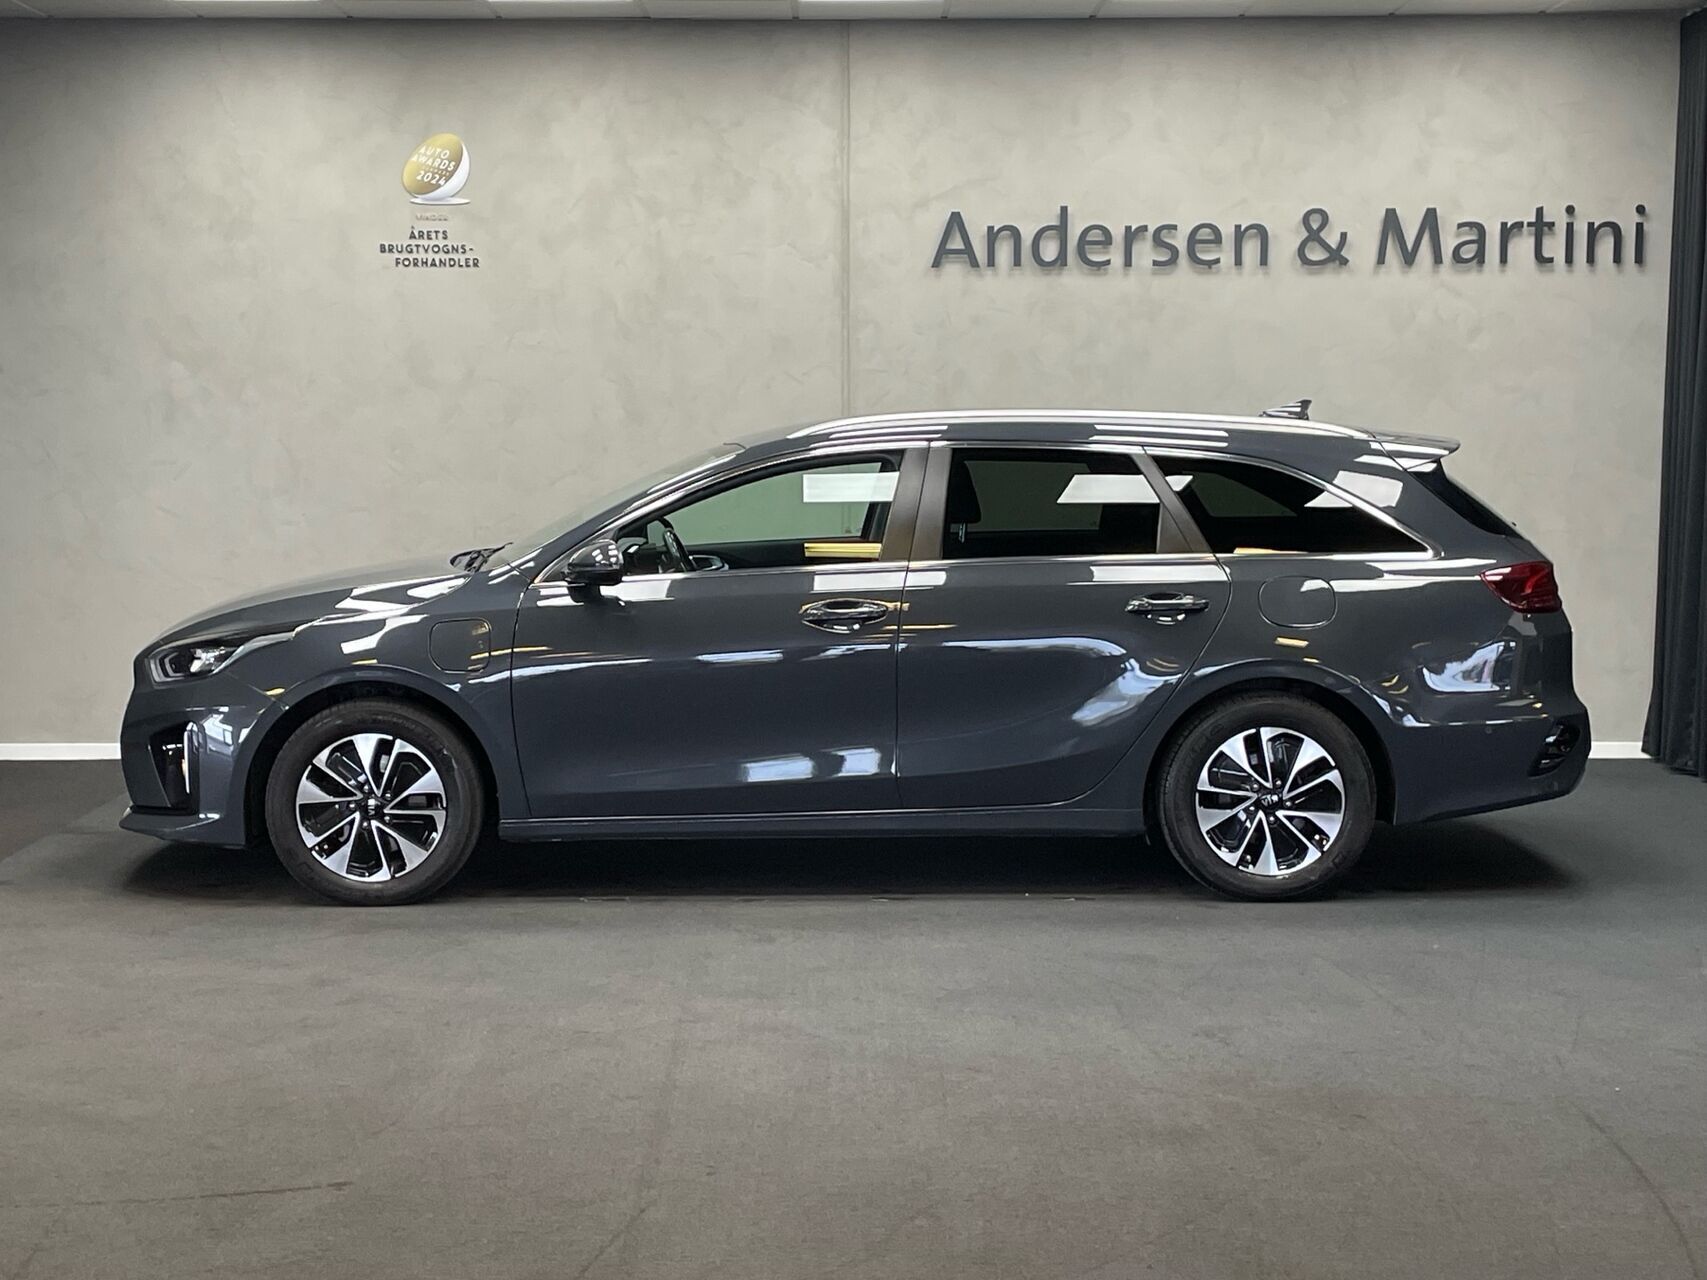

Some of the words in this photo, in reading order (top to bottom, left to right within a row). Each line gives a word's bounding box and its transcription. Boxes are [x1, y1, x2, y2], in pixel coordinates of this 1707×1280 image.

[419, 145, 450, 159] AUTO
[411, 154, 456, 171] AWARDS
[416, 170, 446, 186] 2024
[408, 225, 448, 240] ÅRETS
[931, 205, 1269, 269] Andersen
[1297, 207, 1349, 266] &
[1376, 204, 1646, 266] Martini
[379, 243, 474, 254] BRUGTVOGNS-
[395, 257, 480, 268] FORHANDLER
